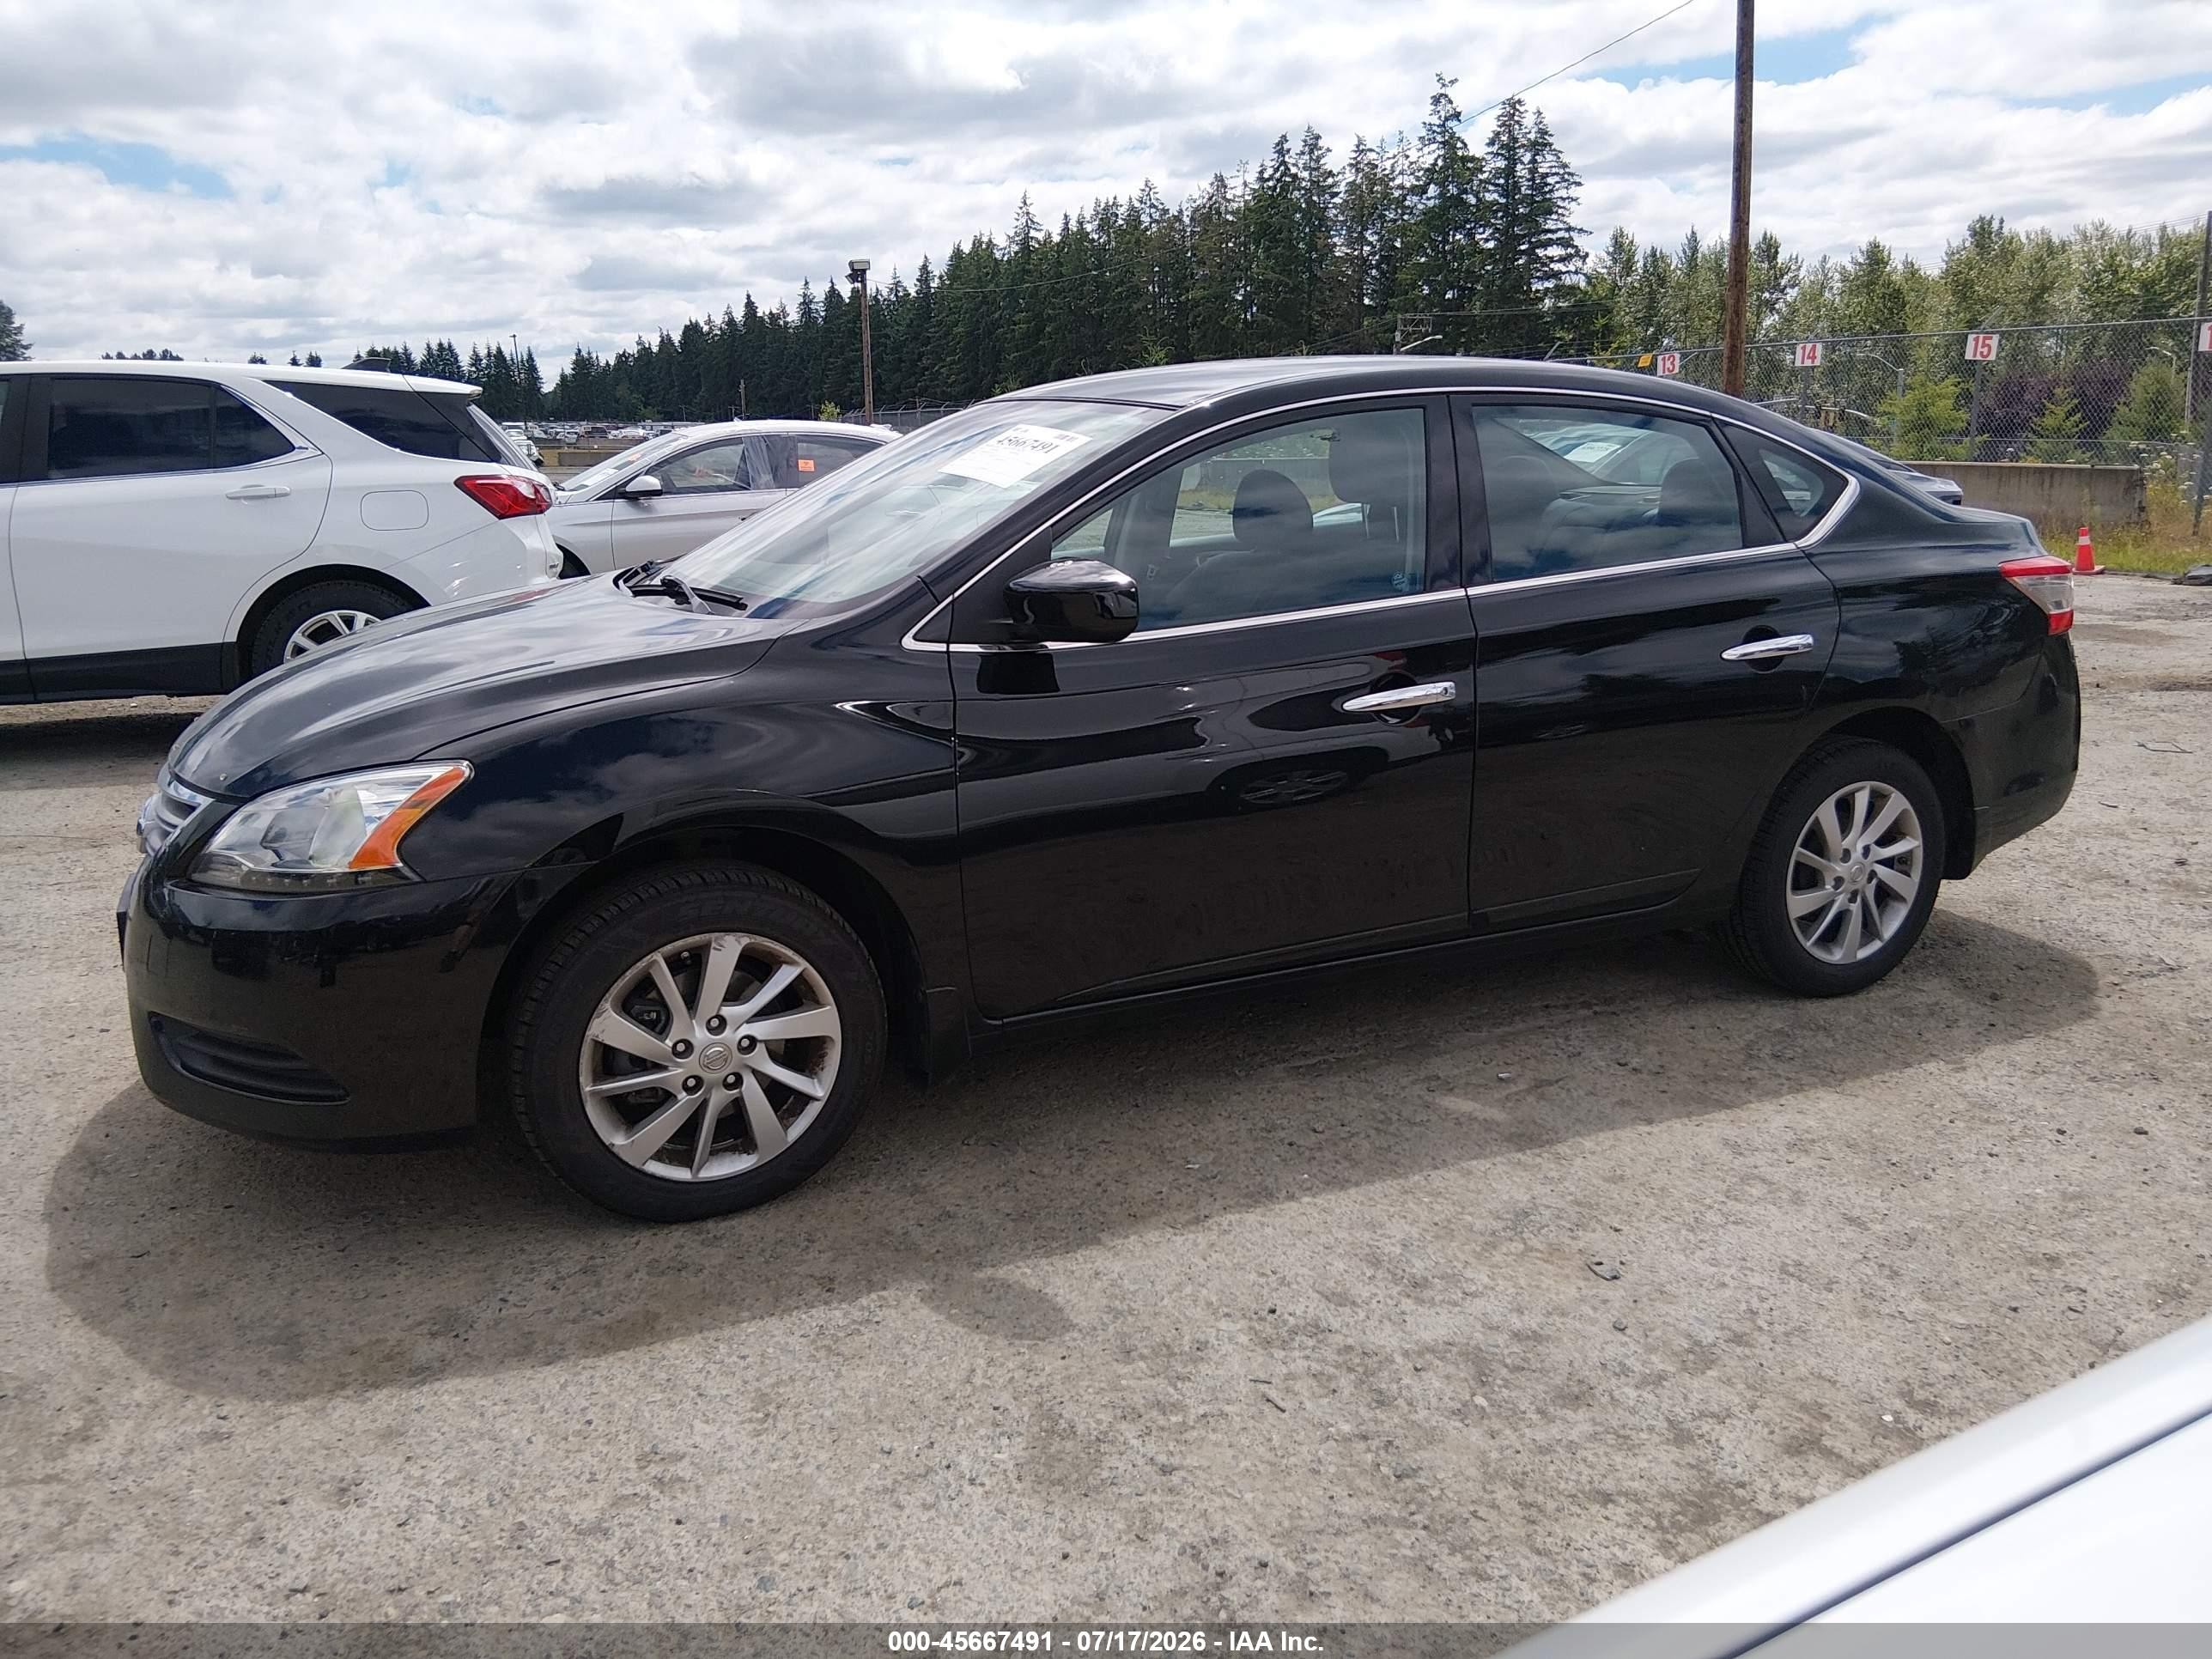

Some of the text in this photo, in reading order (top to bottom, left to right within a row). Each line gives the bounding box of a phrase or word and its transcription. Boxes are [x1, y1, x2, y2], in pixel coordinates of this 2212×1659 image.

[1801, 343, 1817, 365] 14
[1972, 336, 1994, 359] 15
[1661, 354, 1676, 374] 13
